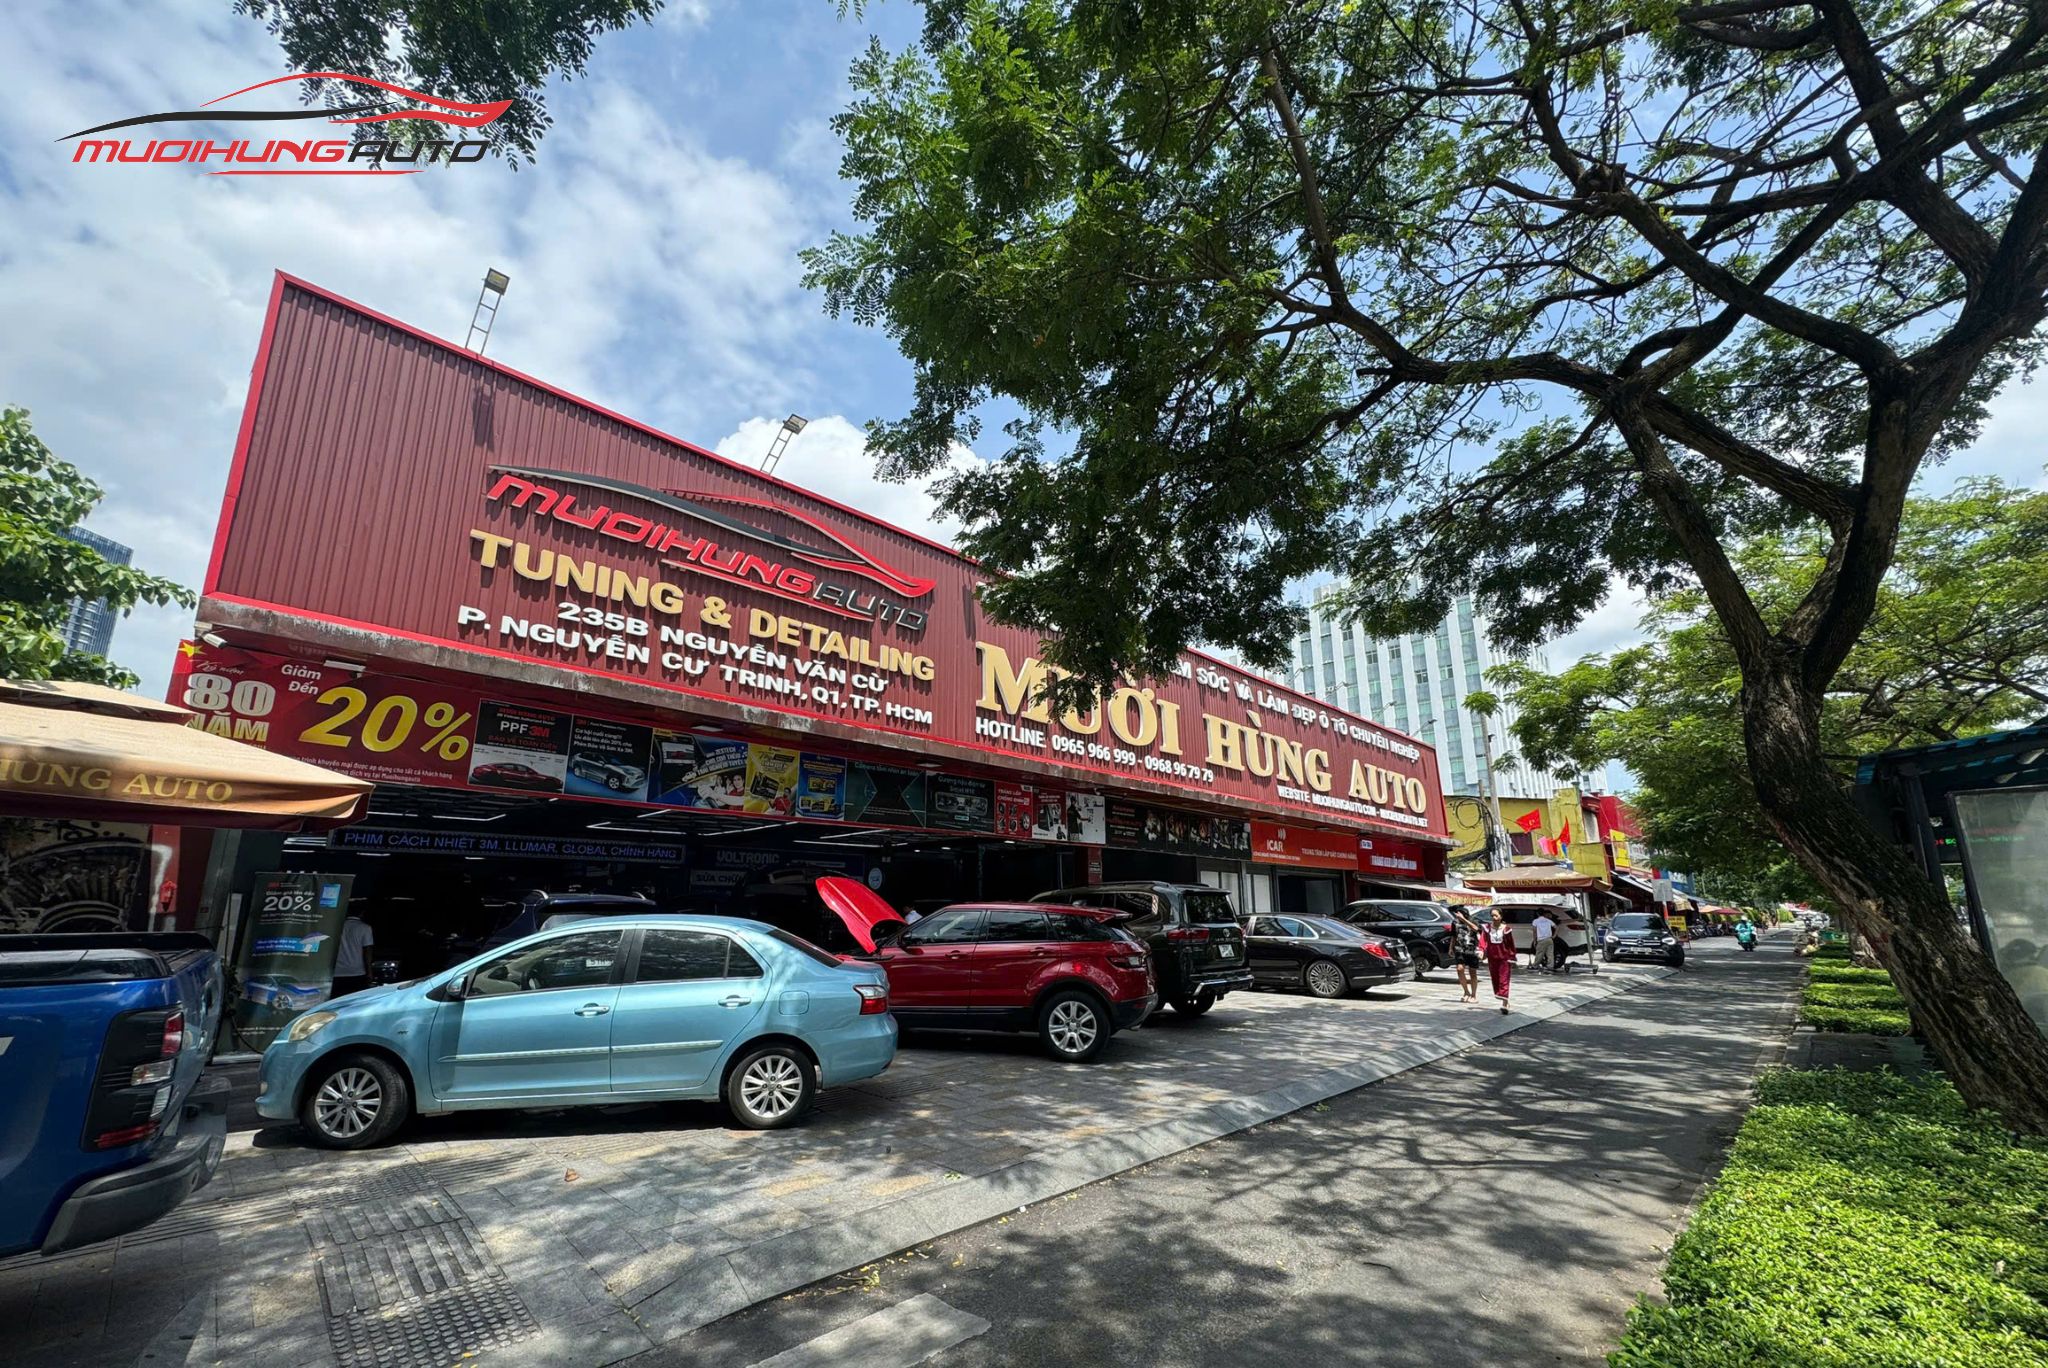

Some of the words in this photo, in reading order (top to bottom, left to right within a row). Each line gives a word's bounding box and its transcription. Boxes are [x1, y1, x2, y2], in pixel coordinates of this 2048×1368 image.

[470, 529, 684, 614] TUNING
[700, 596, 732, 629] &
[750, 608, 935, 681] DETAILING
[457, 605, 491, 630] P.
[500, 615, 650, 664] NGUYỄN
[661, 652, 709, 675] CƯ
[720, 665, 808, 700] TRINH,
[885, 702, 933, 724] HCM
[557, 602, 649, 637] 235B
[660, 625, 786, 670] NGUYỄN
[793, 658, 846, 684] VĂN
[852, 672, 888, 692] CỪ
[281, 664, 321, 681] Giảm
[288, 680, 319, 696] Đến
[183, 672, 276, 716] 80
[1196, 666, 1230, 693] SÓC
[1233, 679, 1254, 702] VÀ
[1257, 689, 1288, 715] LÀM
[1291, 704, 1316, 725] ĐẸP
[1319, 711, 1329, 728] Ô
[1331, 717, 1348, 736] TÔ
[1349, 726, 1389, 750] CHUYÊN
[298, 687, 472, 761] 20%
[500, 720, 529, 734] PPF
[528, 724, 551, 738] 3M
[1052, 735, 1085, 755] 0965
[1088, 743, 1110, 762] 966
[1114, 748, 1136, 766] 999
[1144, 755, 1172, 774] 0968
[1203, 710, 1332, 792] HÙNG
[1349, 759, 1427, 813] AUTO
[122, 773, 233, 801] AUTO
[344, 833, 383, 845] PHIM
[562, 843, 607, 855] GLOBAL
[717, 850, 779, 864] VOLTRONIC
[263, 895, 314, 911] 20%
